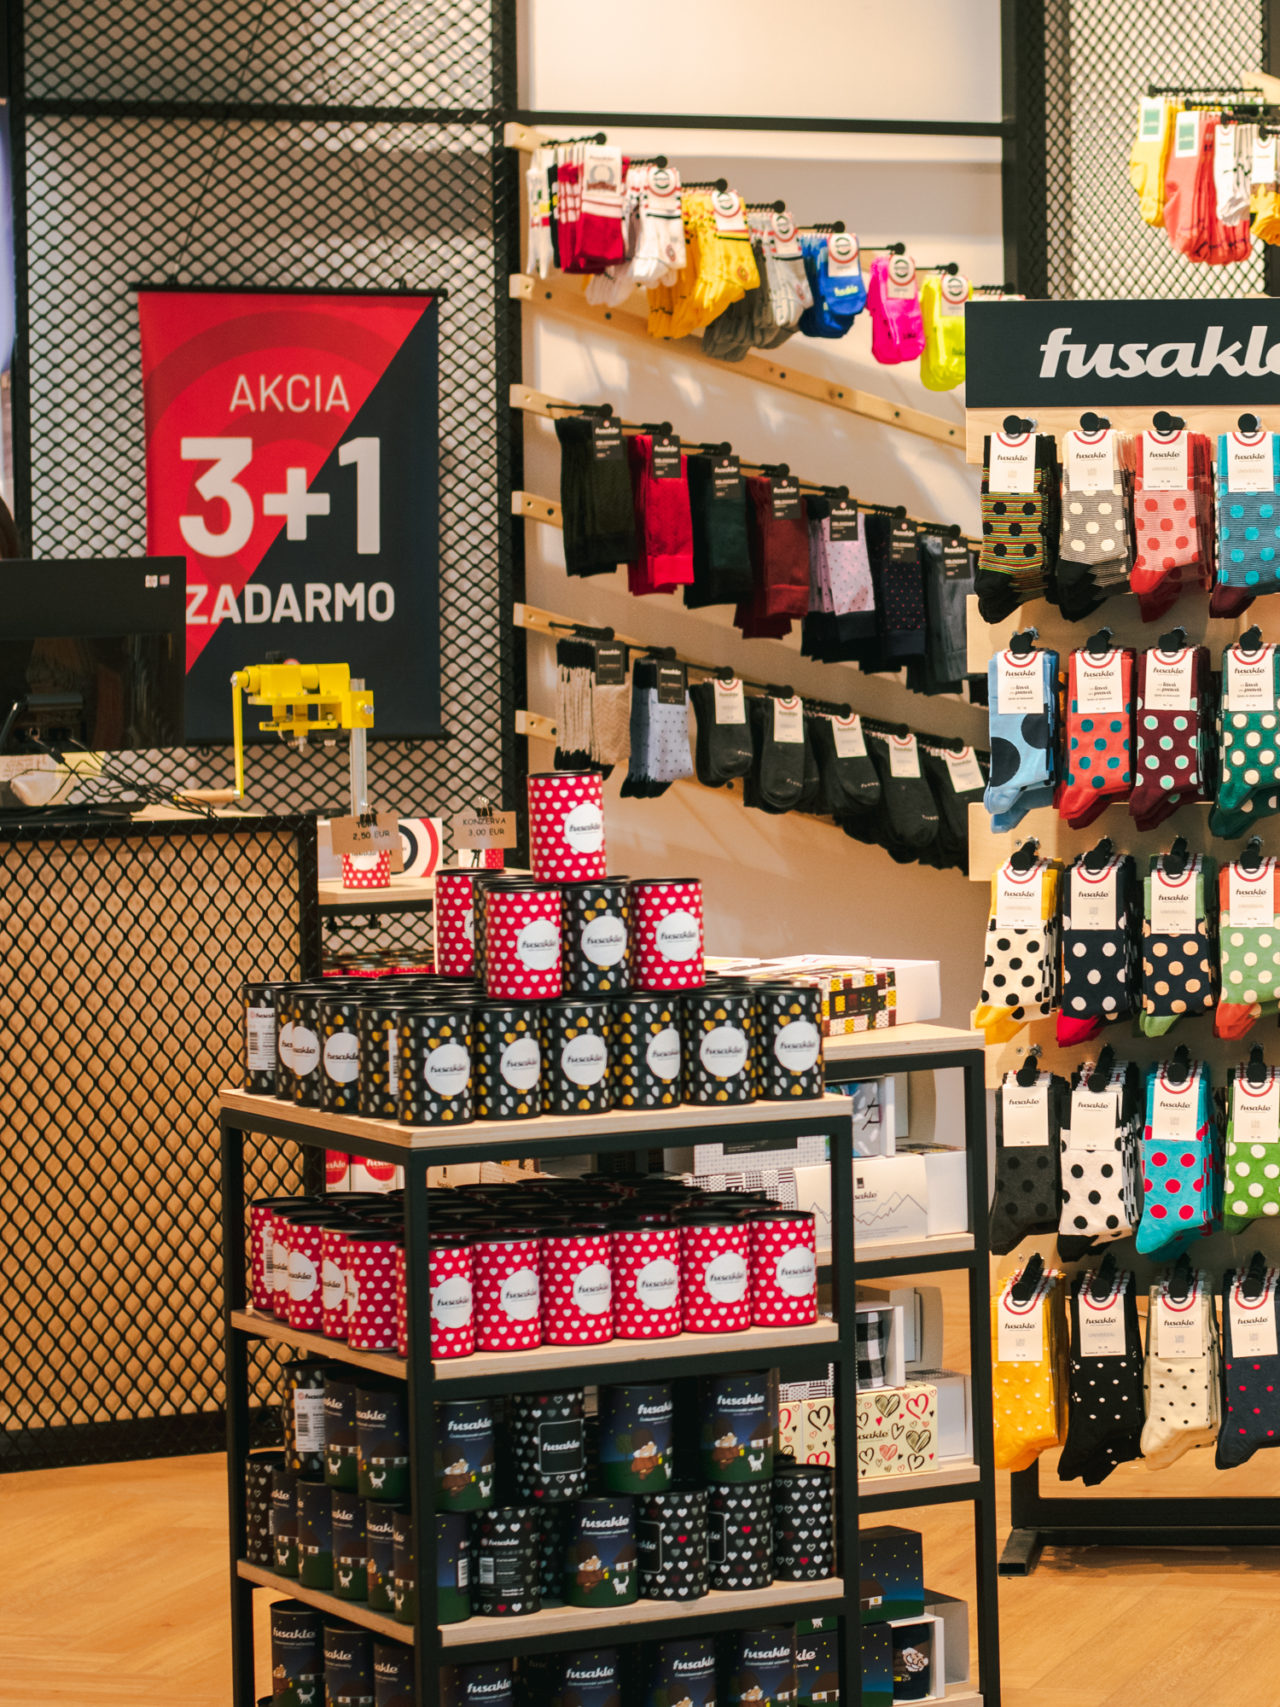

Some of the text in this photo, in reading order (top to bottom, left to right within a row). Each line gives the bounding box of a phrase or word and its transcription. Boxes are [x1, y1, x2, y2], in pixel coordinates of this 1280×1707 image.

[229, 374, 351, 412] AKCIA
[178, 436, 381, 558] 3+1
[185, 582, 396, 625] ZADARMO
[462, 818, 507, 826] KONZERVA
[489, 828, 505, 836] EUR
[743, 1646, 791, 1660] fusakle
[566, 1666, 615, 1680] fusakle
